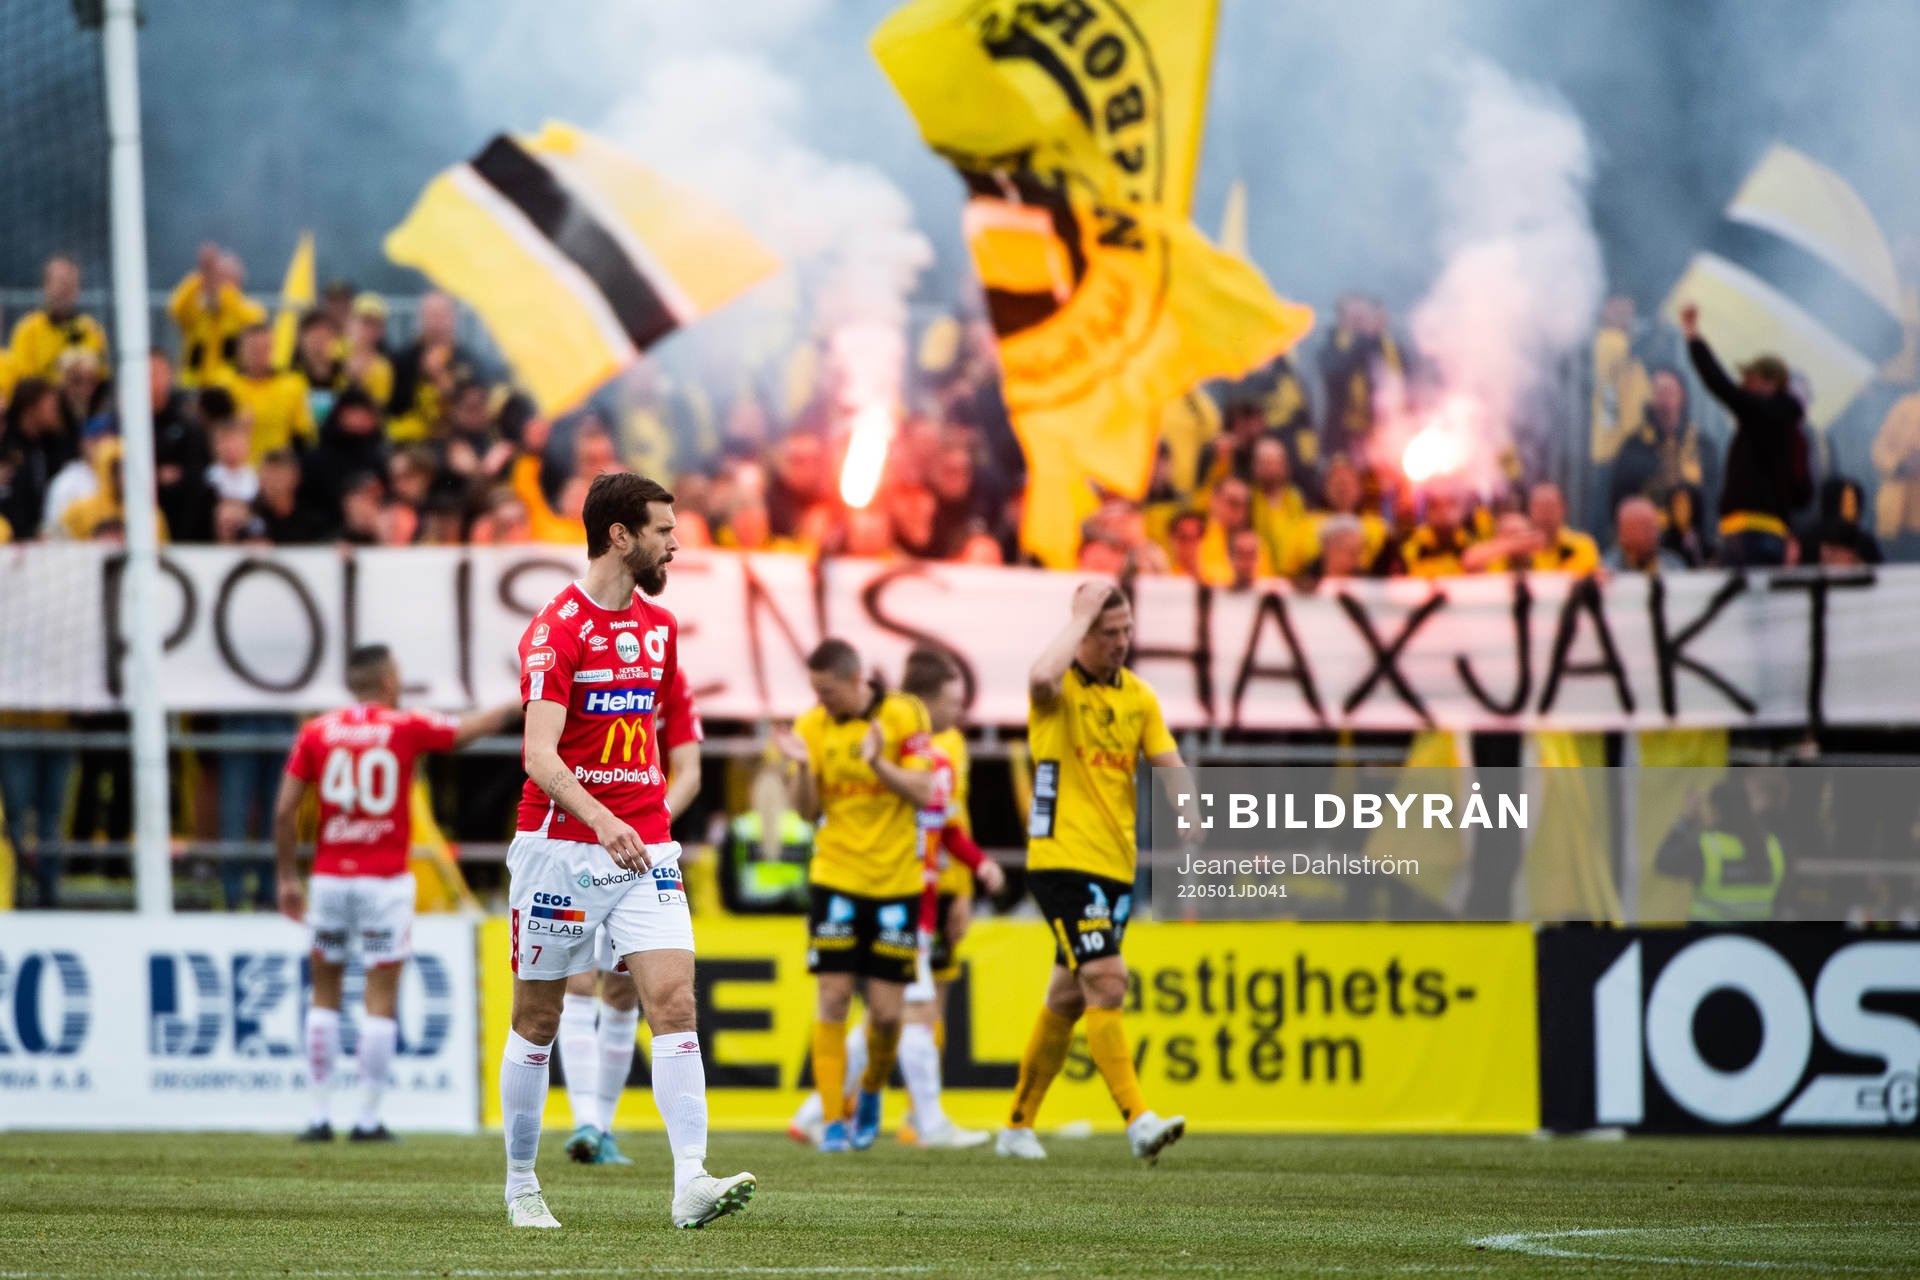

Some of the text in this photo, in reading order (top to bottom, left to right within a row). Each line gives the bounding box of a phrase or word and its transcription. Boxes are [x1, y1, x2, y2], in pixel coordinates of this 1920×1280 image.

[557, 599, 579, 619] AVIS
[617, 643, 639, 653] MHE
[586, 691, 655, 712] Helmi
[321, 747, 399, 815] 40
[533, 892, 572, 907] CEOS
[658, 893, 687, 903] D-L
[528, 920, 583, 936] D-LAB
[1081, 931, 1104, 952] 10
[531, 945, 543, 965] 7
[1124, 954, 1478, 1034] astighets-
